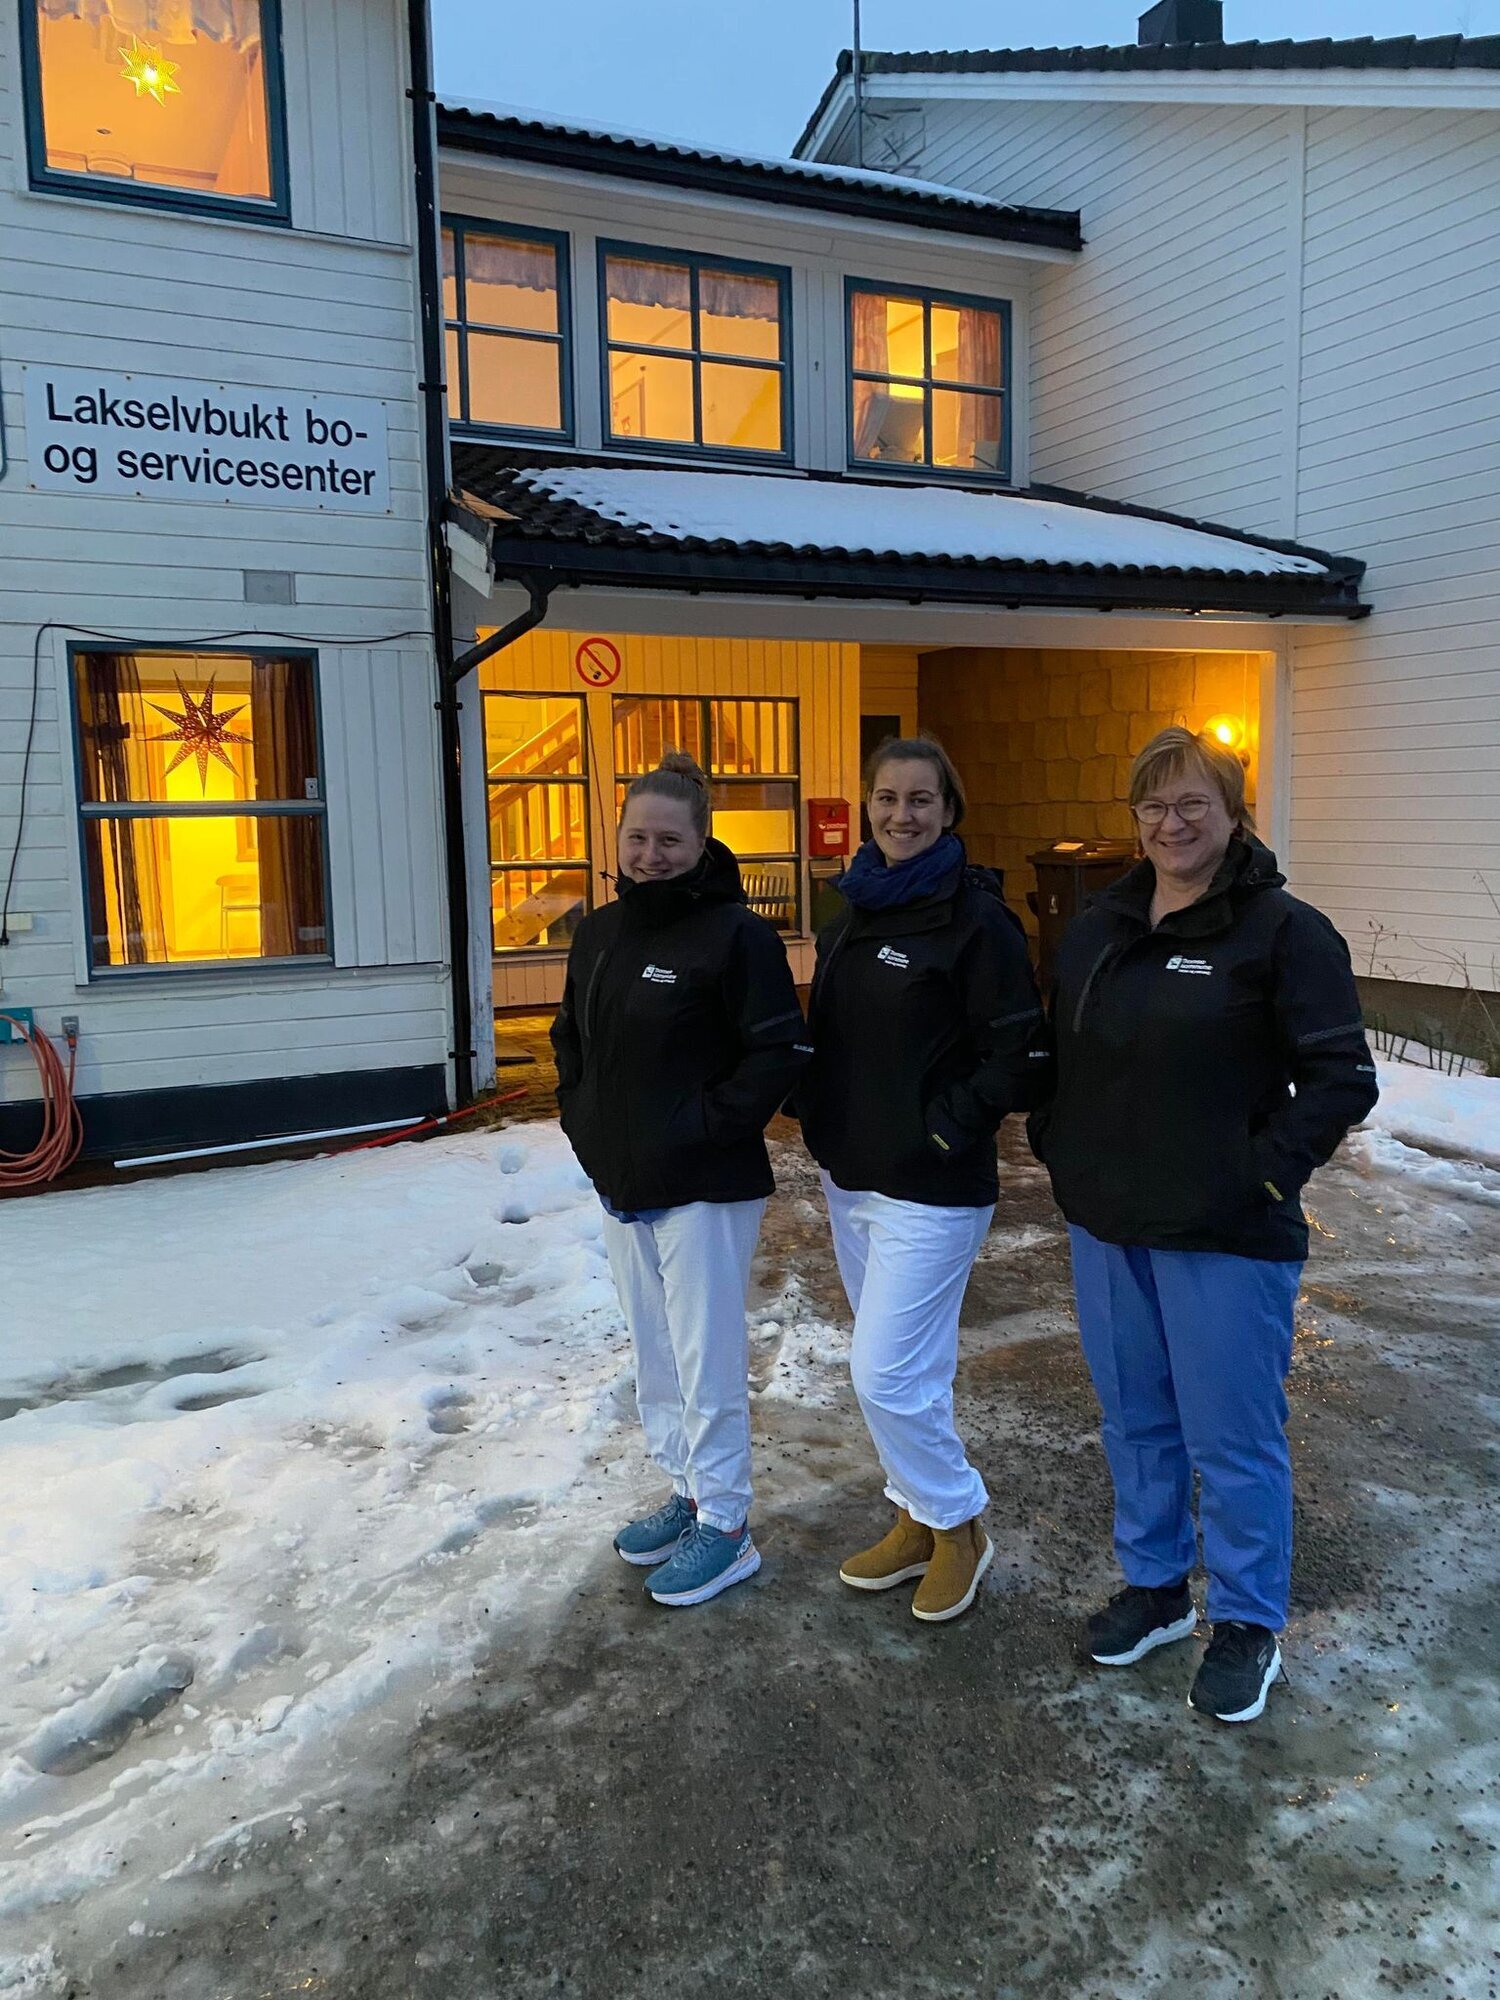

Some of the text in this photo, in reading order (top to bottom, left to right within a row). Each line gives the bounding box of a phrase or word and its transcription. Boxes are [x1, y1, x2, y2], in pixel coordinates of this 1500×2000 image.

[46, 382, 368, 447] Lakselvbukt bo-
[44, 444, 376, 496] og servicesenter
